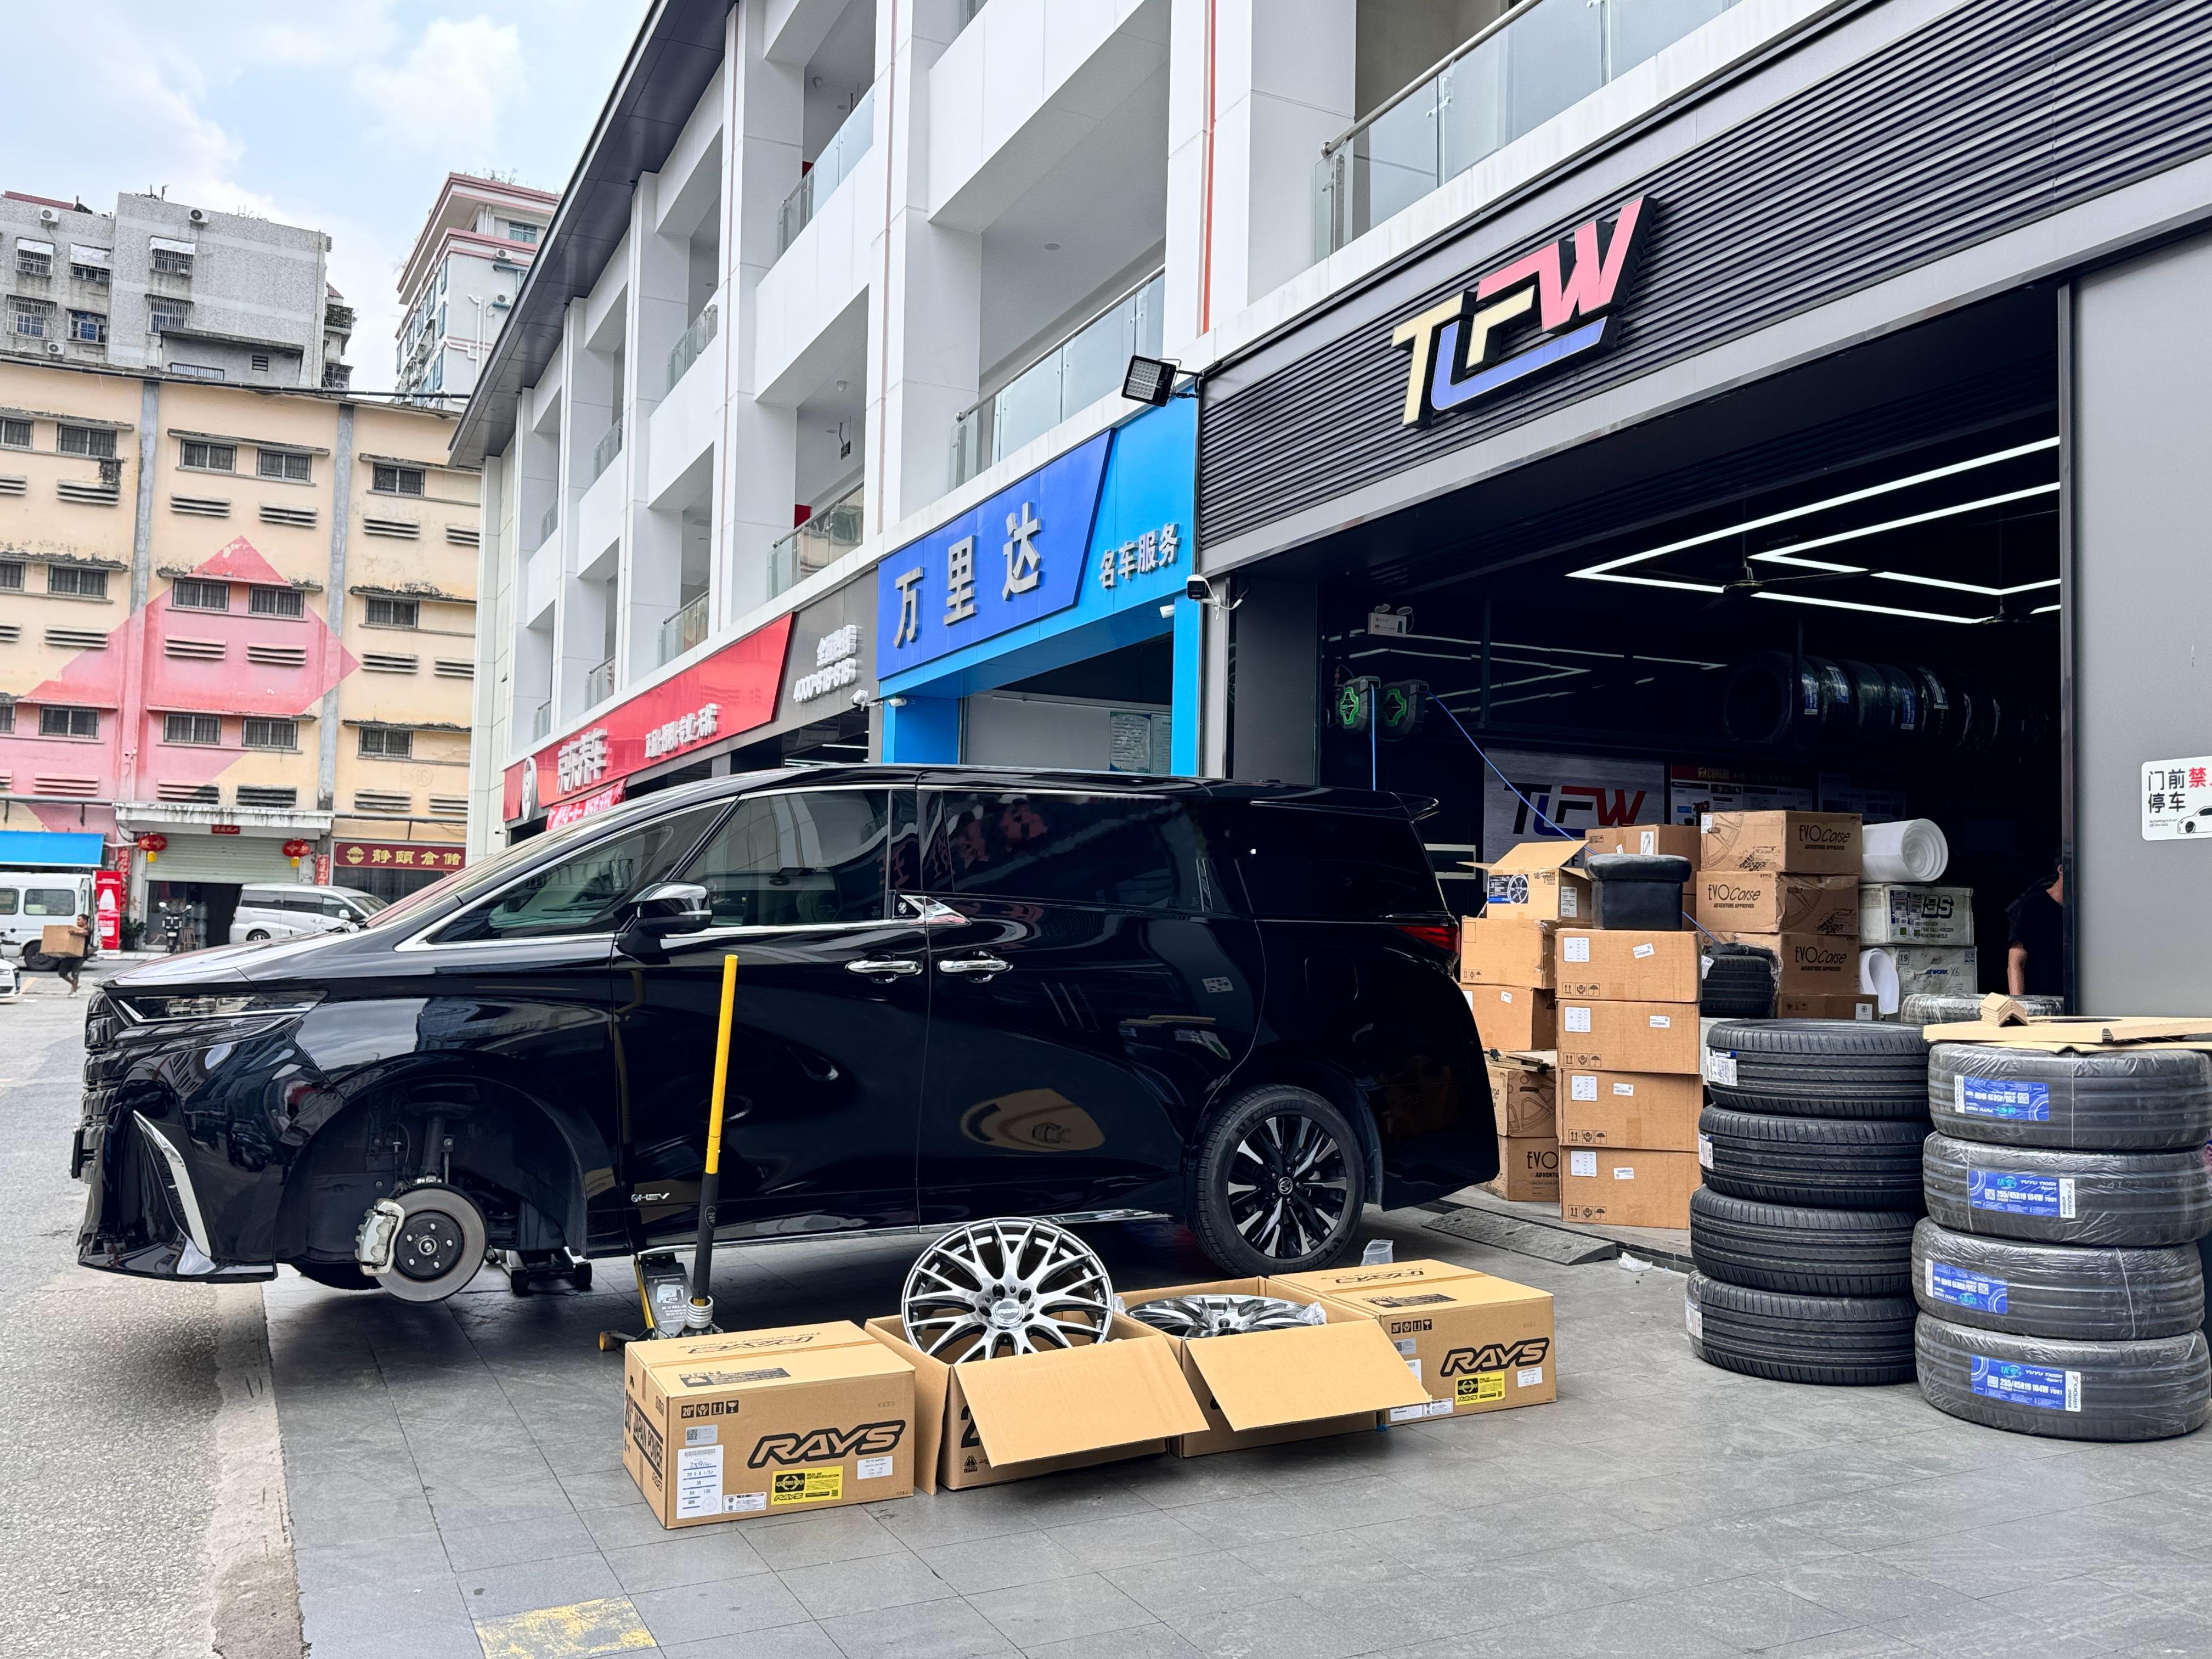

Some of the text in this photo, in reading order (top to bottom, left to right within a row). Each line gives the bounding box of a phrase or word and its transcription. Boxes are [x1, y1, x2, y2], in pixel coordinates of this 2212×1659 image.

[1099, 523, 1181, 589] 名车服务
[894, 501, 1041, 648] 万里达
[2148, 766, 2212, 791] 门前禁
[2148, 791, 2186, 813] 停车
[1921, 894, 1954, 919] BS
[1440, 1337, 1550, 1377] RAYS
[2000, 1378, 2032, 1391] 255/45R19
[2033, 1384, 2049, 1393] 104W
[747, 1420, 906, 1469] RAYS
[774, 1493, 804, 1502] RAYS
